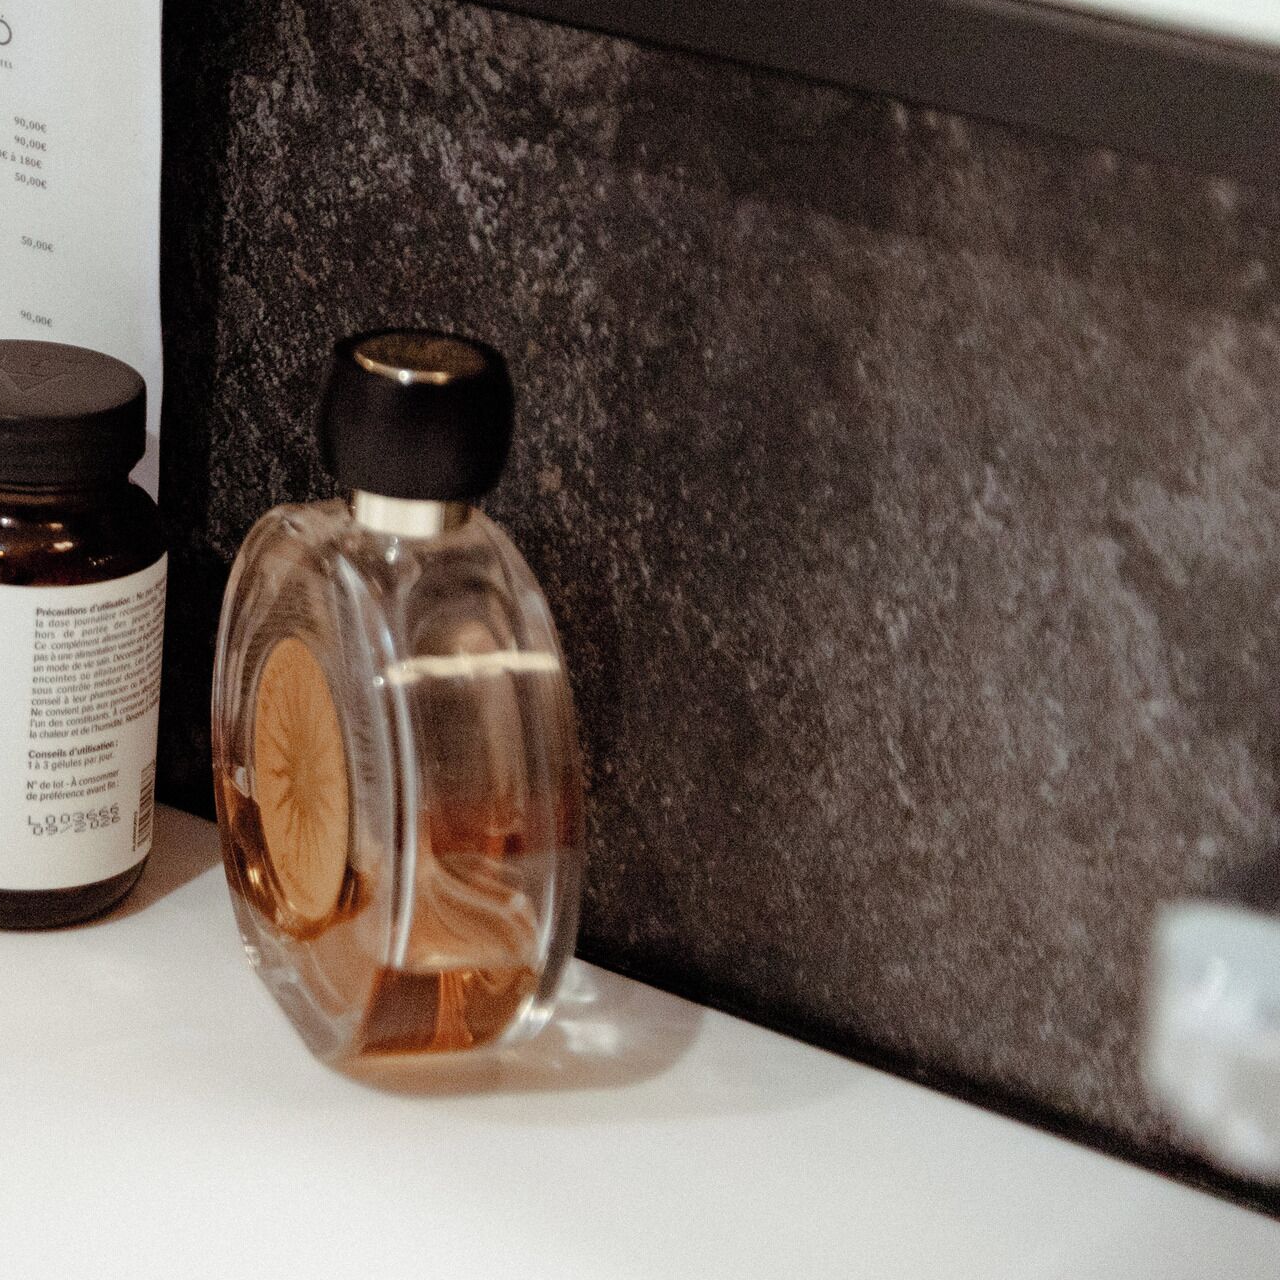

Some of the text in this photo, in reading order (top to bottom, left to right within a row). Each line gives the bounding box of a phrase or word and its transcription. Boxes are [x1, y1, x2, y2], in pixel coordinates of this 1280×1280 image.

[14, 115, 48, 134] 90,00€
[14, 134, 48, 152] 90,00€
[19, 155, 43, 169] 180€
[36, 606, 87, 617] Précautions
[48, 616, 72, 628] dose
[34, 630, 56, 639] hors
[63, 629, 75, 639] de
[34, 640, 47, 650] Ce
[50, 636, 100, 652] complément
[33, 652, 49, 663] pas
[57, 651, 73, 661] une
[33, 663, 44, 672] un
[46, 661, 70, 672] mode
[71, 660, 82, 671] de
[32, 673, 77, 684] enceintes
[31, 686, 53, 695] sous
[56, 681, 91, 695] contrôle
[31, 695, 61, 706] conseil
[72, 692, 87, 704] leur
[30, 707, 43, 717] Ne
[45, 705, 80, 717] convient
[81, 704, 95, 716] pas
[29, 718, 47, 728] l'un
[48, 716, 64, 728] des
[29, 729, 37, 739] la
[39, 726, 69, 739] chaleur
[71, 725, 79, 736] et
[80, 725, 90, 736] de
[28, 748, 67, 760] Conseils
[34, 759, 41, 770] à
[43, 760, 49, 770] 3
[51, 756, 82, 772] gélules
[83, 756, 96, 768] par
[39, 780, 51, 789] de
[52, 779, 64, 789] lot
[78, 769, 120, 786] consommer
[25, 791, 38, 801] de
[40, 789, 85, 802] préférence
[86, 783, 107, 795] avant
